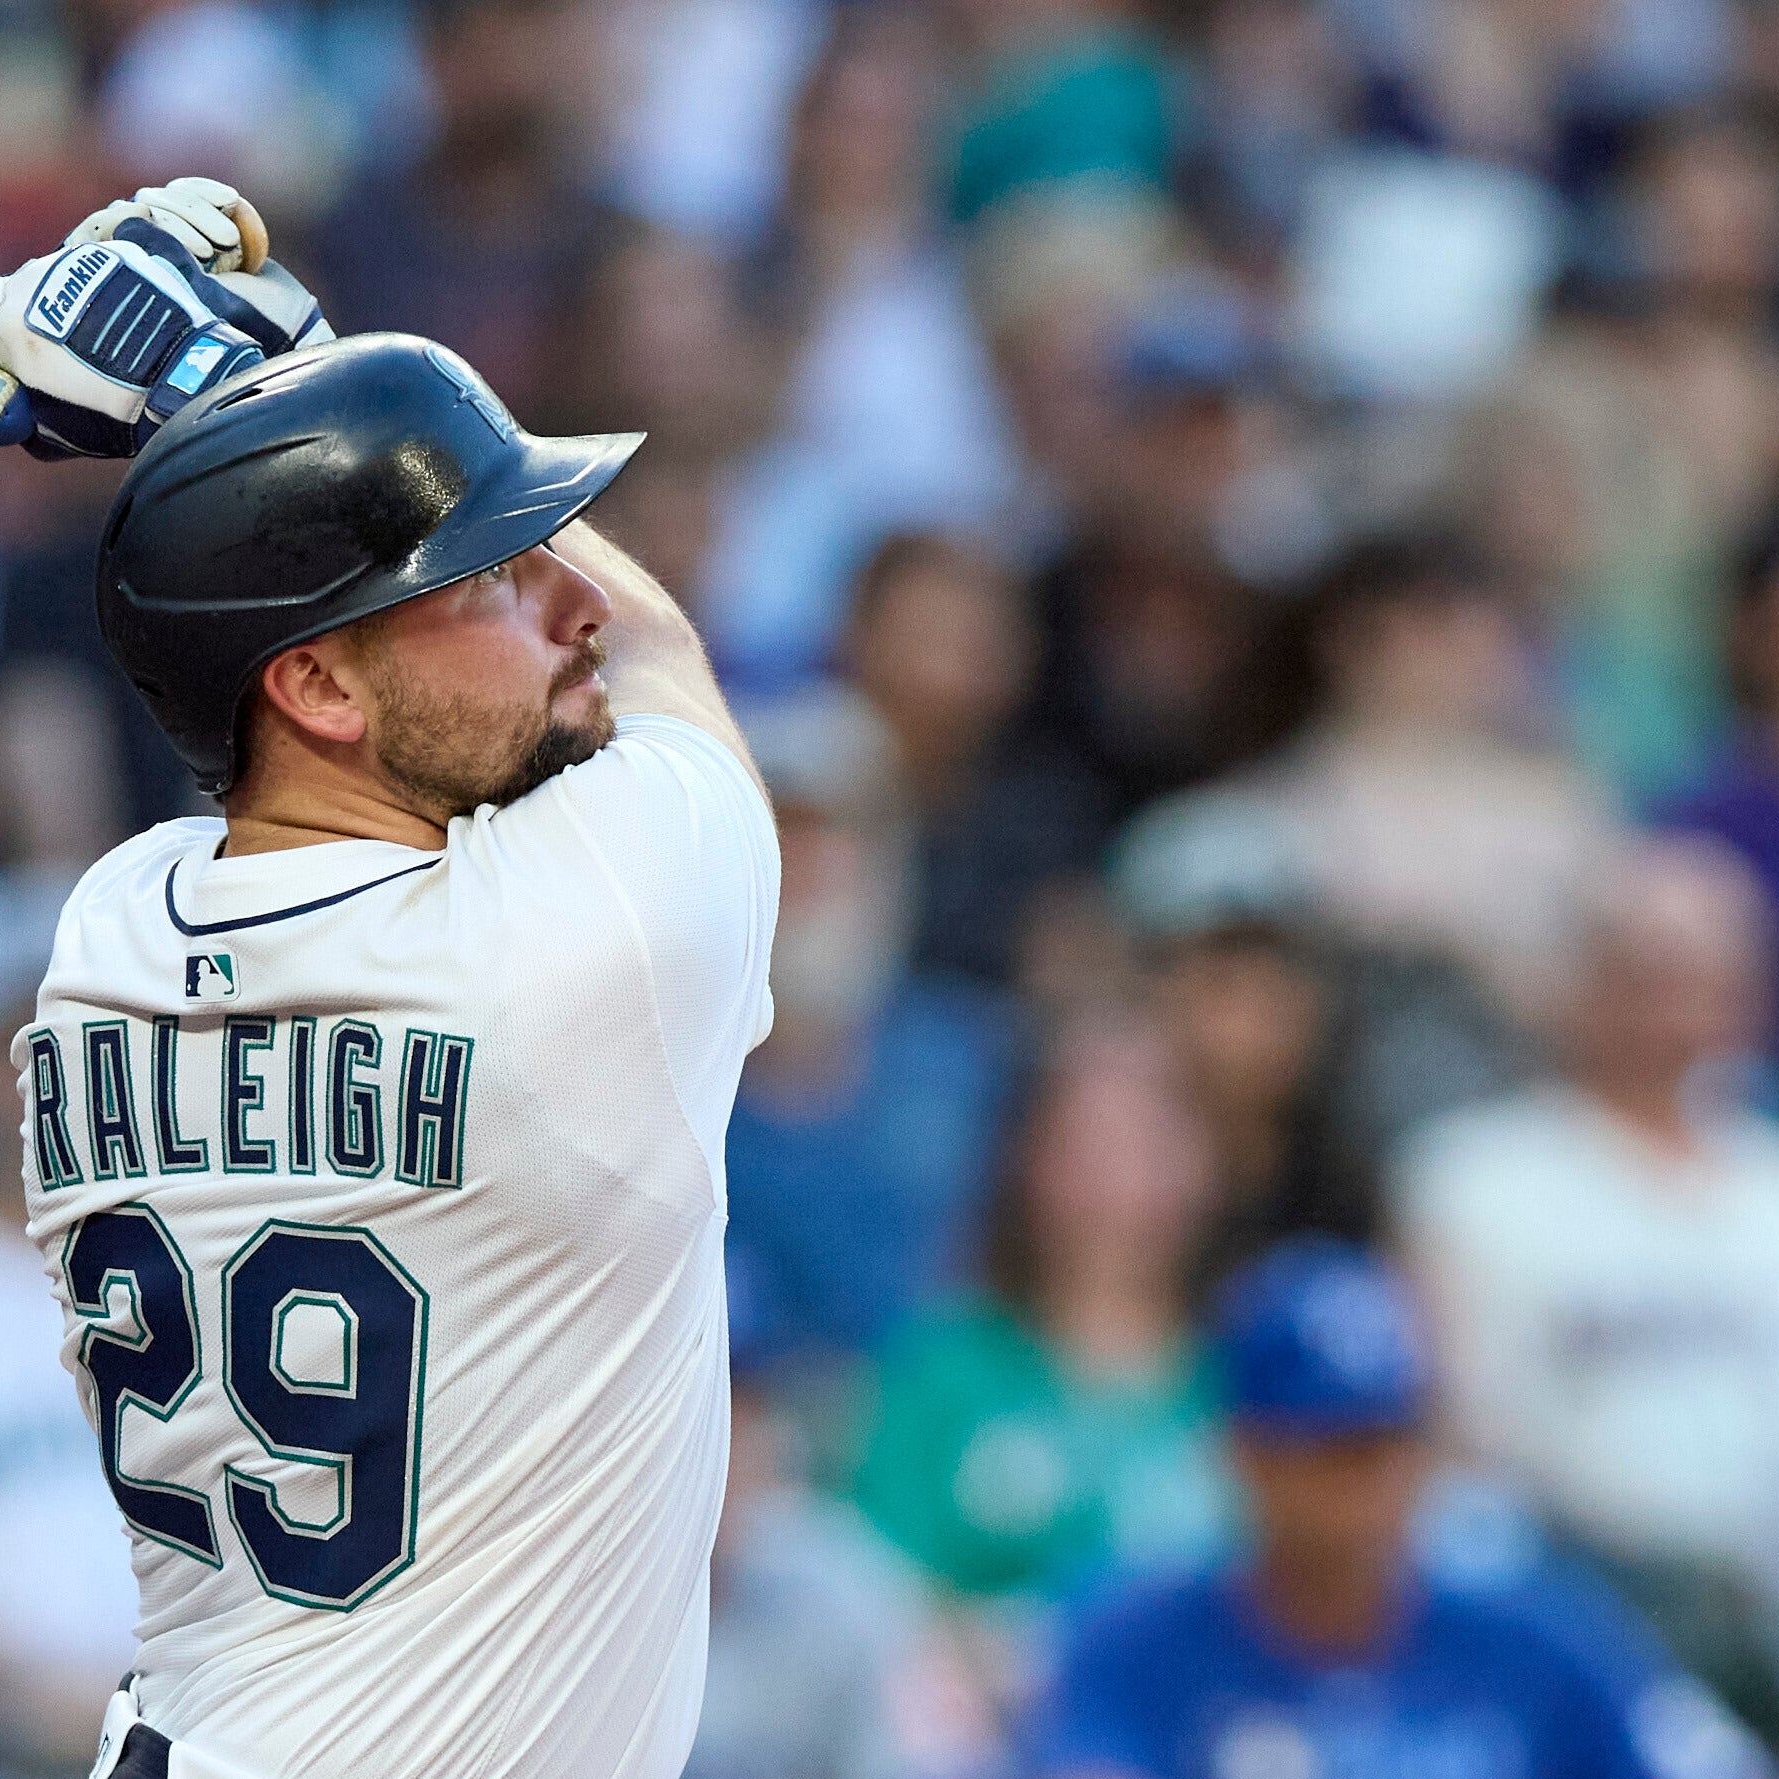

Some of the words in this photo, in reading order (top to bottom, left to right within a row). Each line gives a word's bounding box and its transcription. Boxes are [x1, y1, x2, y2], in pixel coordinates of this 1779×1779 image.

[38, 249, 110, 332] Franklin
[28, 1014, 475, 1191] RALEIGH
[62, 1201, 430, 1614] 29
